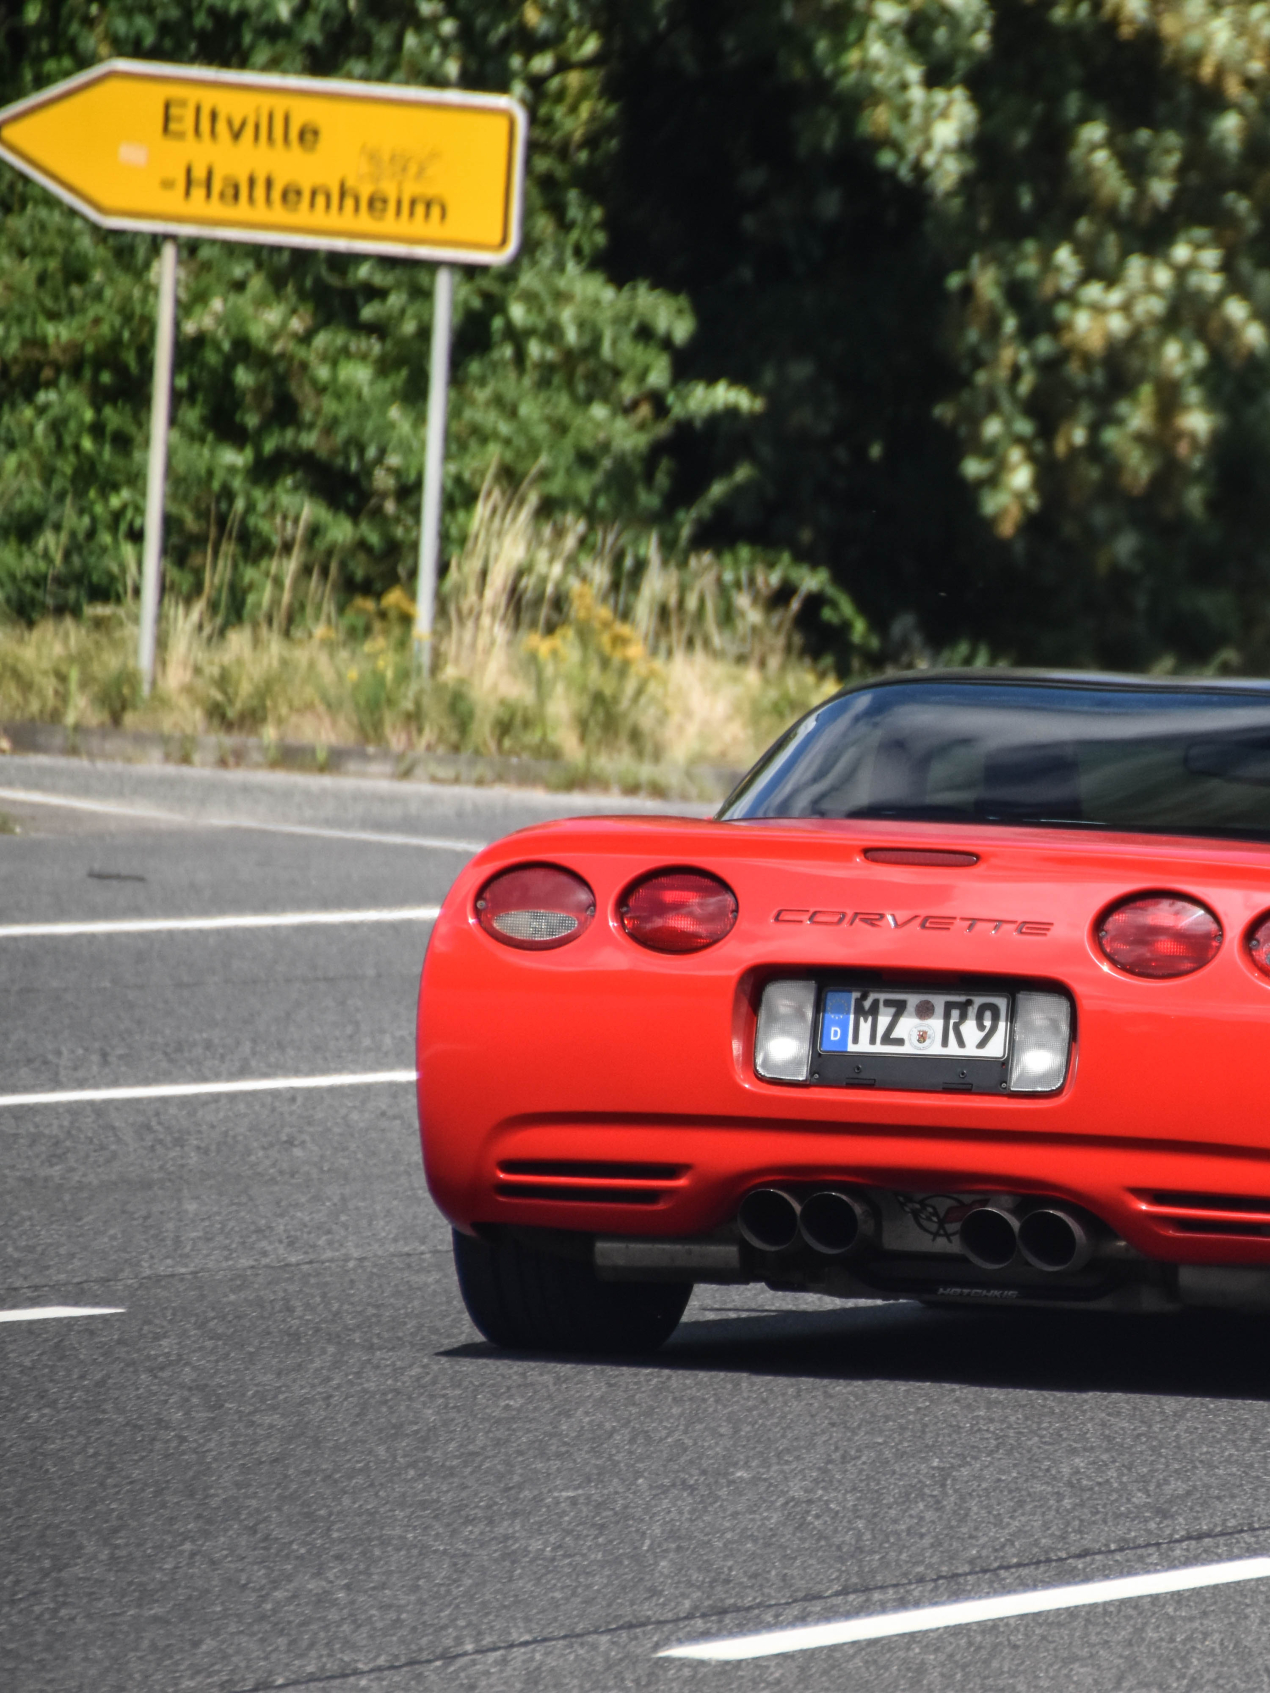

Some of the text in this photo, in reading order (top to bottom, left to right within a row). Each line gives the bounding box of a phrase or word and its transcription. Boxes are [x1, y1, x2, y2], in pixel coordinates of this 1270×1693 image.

[163, 98, 321, 152] Eltville
[160, 161, 448, 224] -Hattenheim
[771, 908, 1054, 936] CORVETTE
[830, 1027, 841, 1041] D
[851, 997, 1000, 1049] MZ R9
